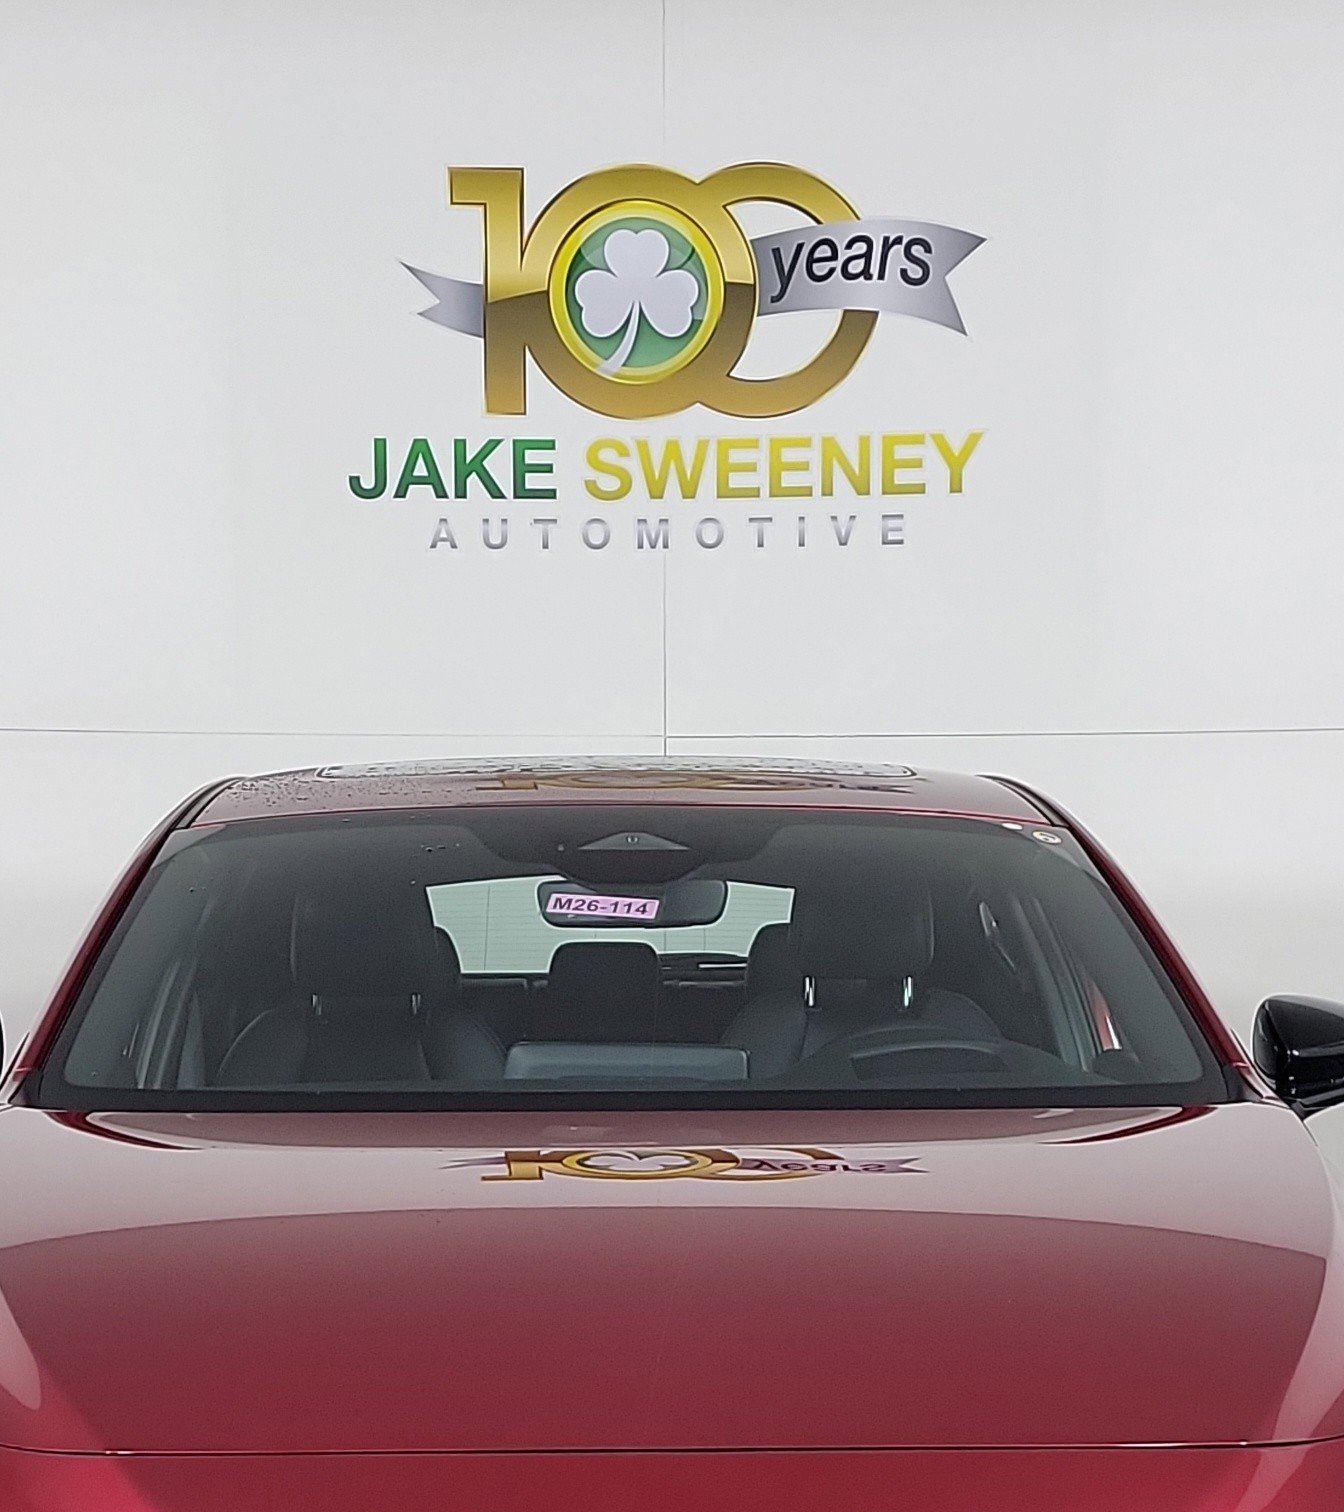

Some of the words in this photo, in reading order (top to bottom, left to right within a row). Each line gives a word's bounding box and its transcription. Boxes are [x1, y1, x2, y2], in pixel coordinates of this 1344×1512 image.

[448, 163, 878, 418] 100
[770, 234, 932, 304] years
[348, 438, 557, 499] JAKE
[583, 432, 986, 500] SWEENEY
[430, 514, 905, 549] AUTOMOTIVE
[553, 898, 648, 915] M26-114
